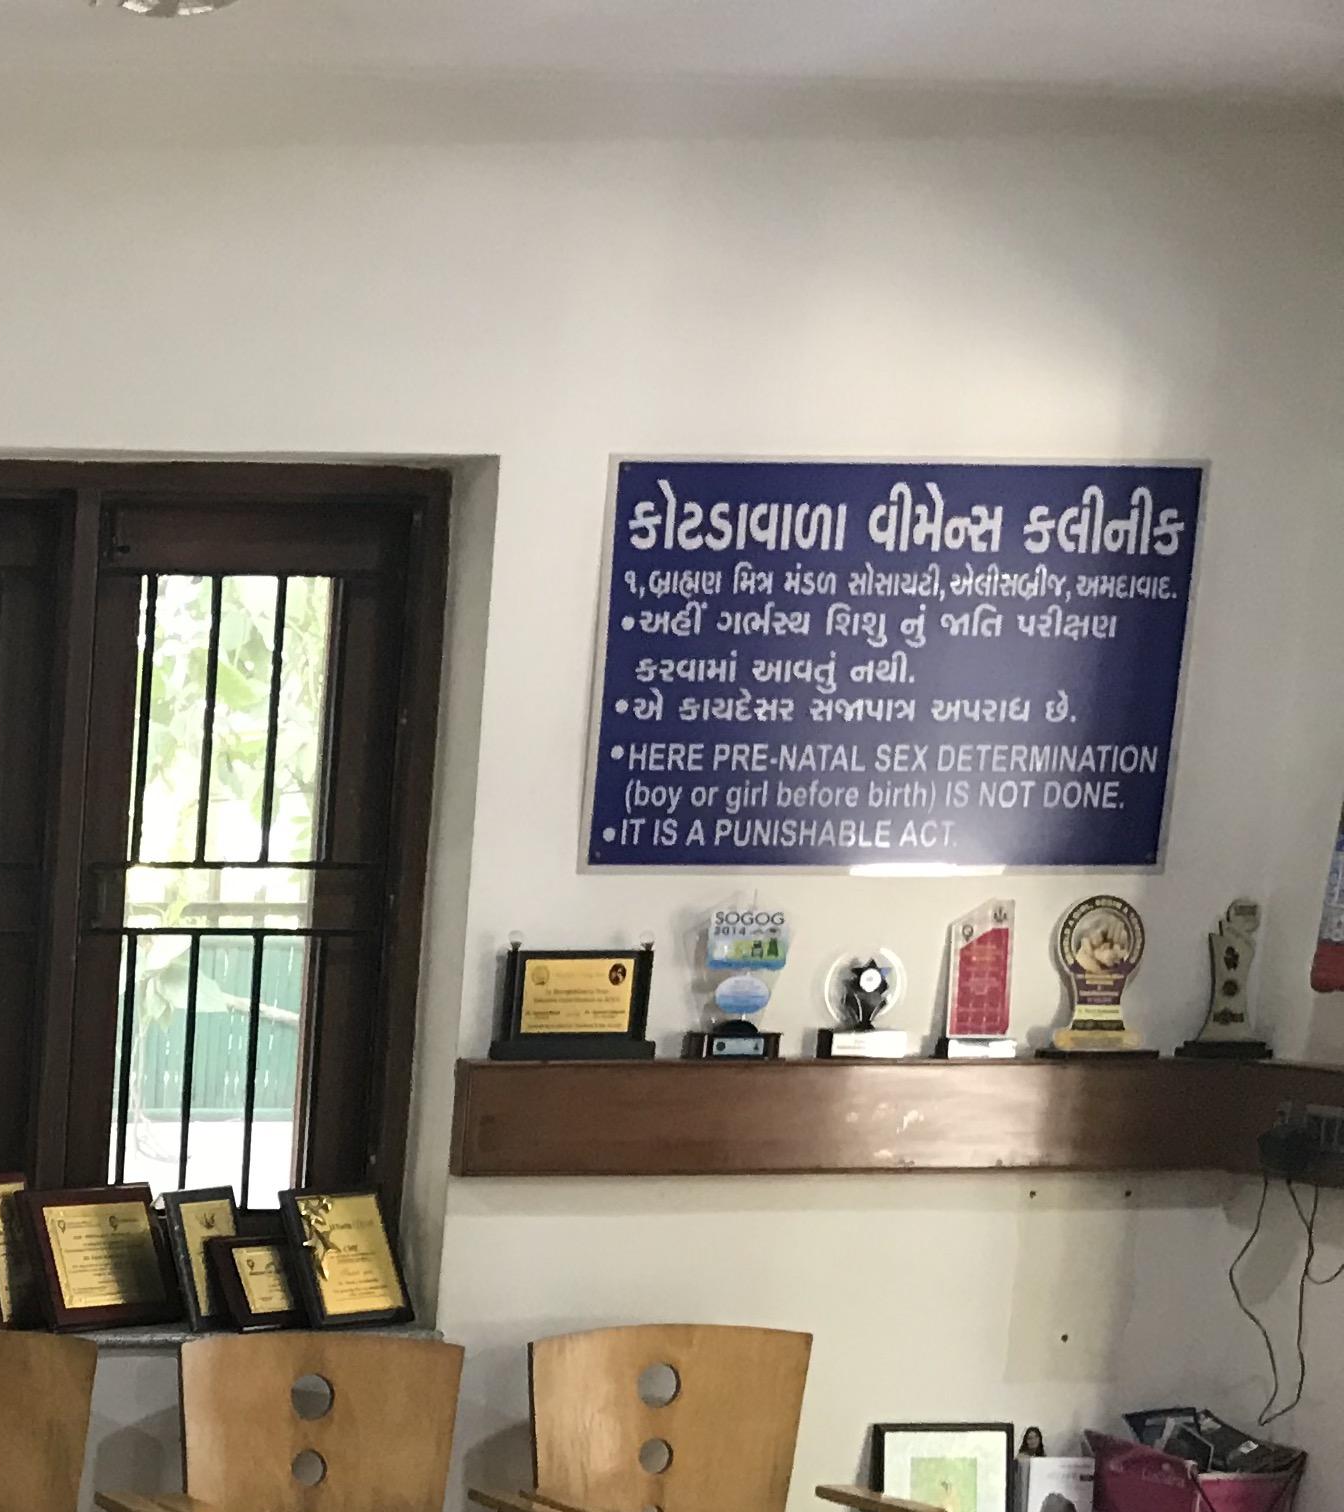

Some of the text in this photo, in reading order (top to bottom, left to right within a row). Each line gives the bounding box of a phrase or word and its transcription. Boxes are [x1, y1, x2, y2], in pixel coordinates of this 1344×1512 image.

[628, 478, 848, 552] કોટડાવાળા
[868, 480, 1004, 554] વીમેન્સ
[732, 560, 774, 597] મિત્ર
[783, 562, 837, 598] મંડળ
[825, 602, 888, 649] શિશુ
[939, 603, 1004, 639] જાતિ
[1017, 604, 1118, 643] પરીક્ષણ
[634, 649, 916, 696] કરવામાં આવતું નથી.
[678, 688, 795, 723] કાયદેસર
[808, 697, 916, 724] સજાપાત્ર
[929, 697, 1031, 725] અપરાધ
[1044, 689, 1078, 726] છે.
[627, 743, 1159, 774] HERE PRE-NATAL SEX DETERMINATION
[624, 778, 1125, 816] (boy or girl before birth) IS NOT DONE.
[620, 817, 959, 849] IT IS A PUNISHABLE ACT.
[716, 911, 785, 926] SOGOG
